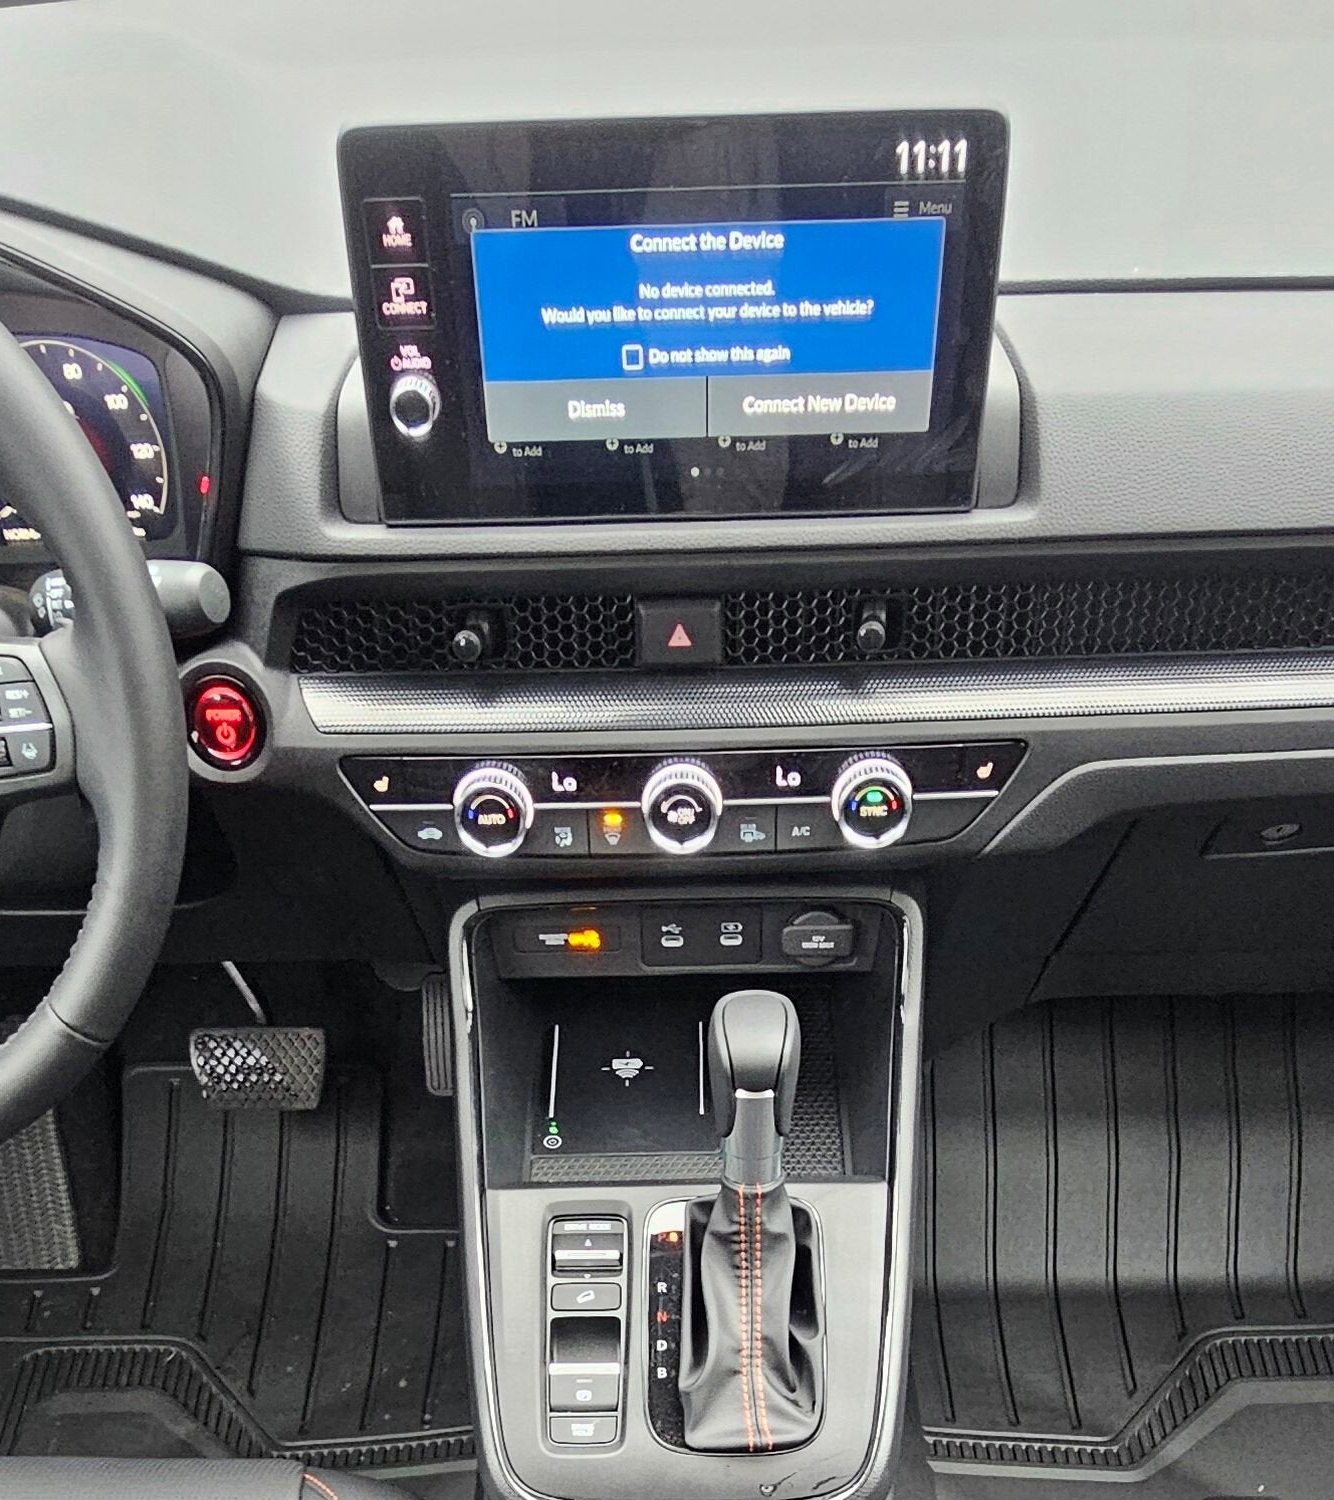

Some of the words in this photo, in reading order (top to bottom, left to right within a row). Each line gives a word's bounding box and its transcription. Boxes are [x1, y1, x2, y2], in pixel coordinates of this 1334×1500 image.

[895, 139, 968, 175] 11:11
[919, 201, 953, 215] Menu
[510, 210, 539, 228] FM
[382, 233, 413, 248] HOME
[629, 233, 698, 253] Connect
[699, 231, 727, 251] the
[729, 231, 785, 250] Device
[639, 283, 660, 299] No
[661, 282, 704, 298] device
[705, 279, 776, 297] connected.
[382, 301, 428, 315] CONNECT
[541, 306, 585, 325] Would
[586, 308, 611, 326] you
[612, 305, 637, 322] like
[637, 305, 653, 321] to
[654, 303, 705, 320] connect
[707, 304, 738, 322] your
[739, 302, 781, 318] device
[782, 302, 797, 317] to
[799, 300, 822, 317] the
[823, 299, 875, 316] vehicle?
[648, 347, 670, 364] Do
[670, 348, 694, 363] not
[695, 346, 729, 363] show
[730, 346, 755, 362] this
[755, 345, 792, 364] again
[567, 399, 627, 418] Dismiss
[742, 395, 805, 415] Connect
[807, 394, 843, 413] New
[844, 392, 897, 412] Device
[623, 444, 634, 454] to
[635, 443, 655, 454] Add
[735, 441, 746, 451] to
[747, 440, 767, 451] Add
[847, 439, 858, 449] to
[859, 437, 879, 449] Add
[511, 447, 524, 457] to
[524, 446, 543, 457] Add
[205, 708, 242, 722] POWER
[551, 771, 578, 792] Lo
[775, 765, 802, 788] Lo
[859, 805, 888, 817] SYNC
[478, 813, 505, 825] AUTO
[792, 825, 811, 837] A/C
[657, 1281, 668, 1293] R
[657, 1312, 668, 1322] N
[657, 1340, 668, 1351] D
[657, 1367, 668, 1379] B
